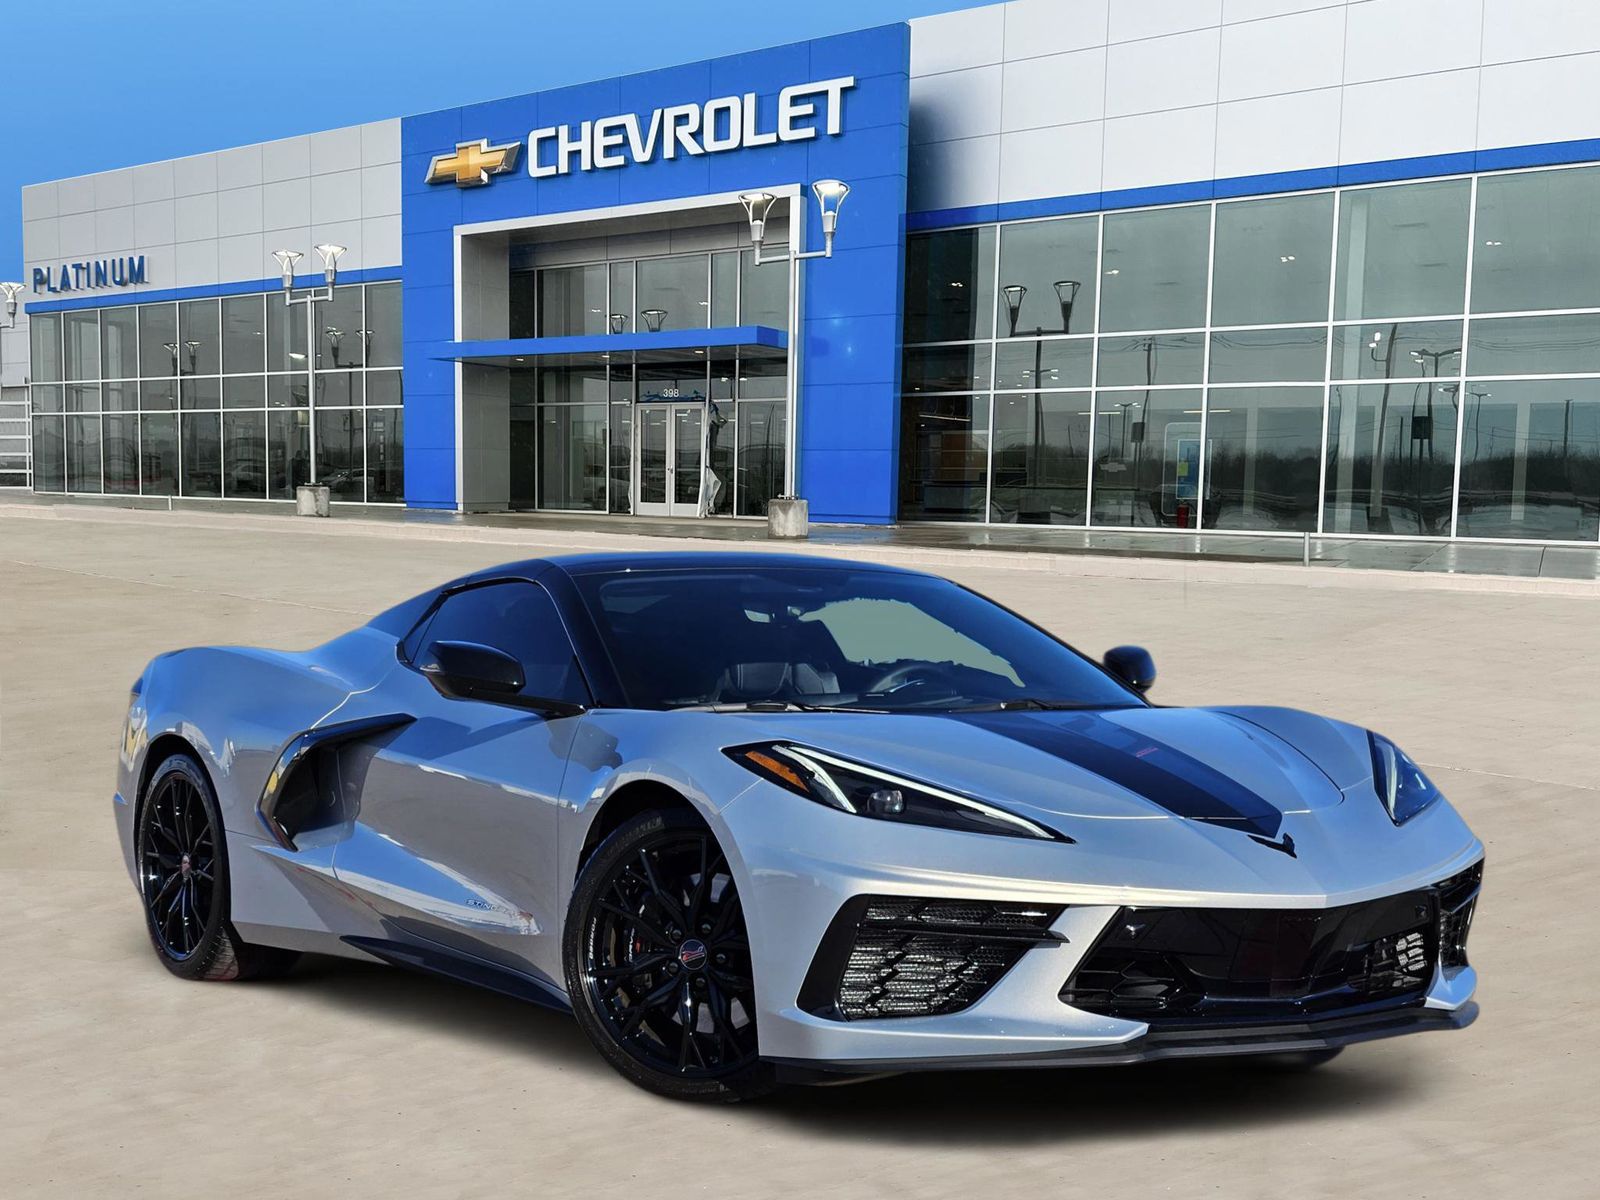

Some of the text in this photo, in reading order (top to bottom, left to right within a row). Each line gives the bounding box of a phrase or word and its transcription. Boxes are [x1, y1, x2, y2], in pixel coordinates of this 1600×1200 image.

[527, 75, 855, 178] CHEVROLET
[33, 255, 145, 293] PLATINUM
[663, 388, 679, 398] 398
